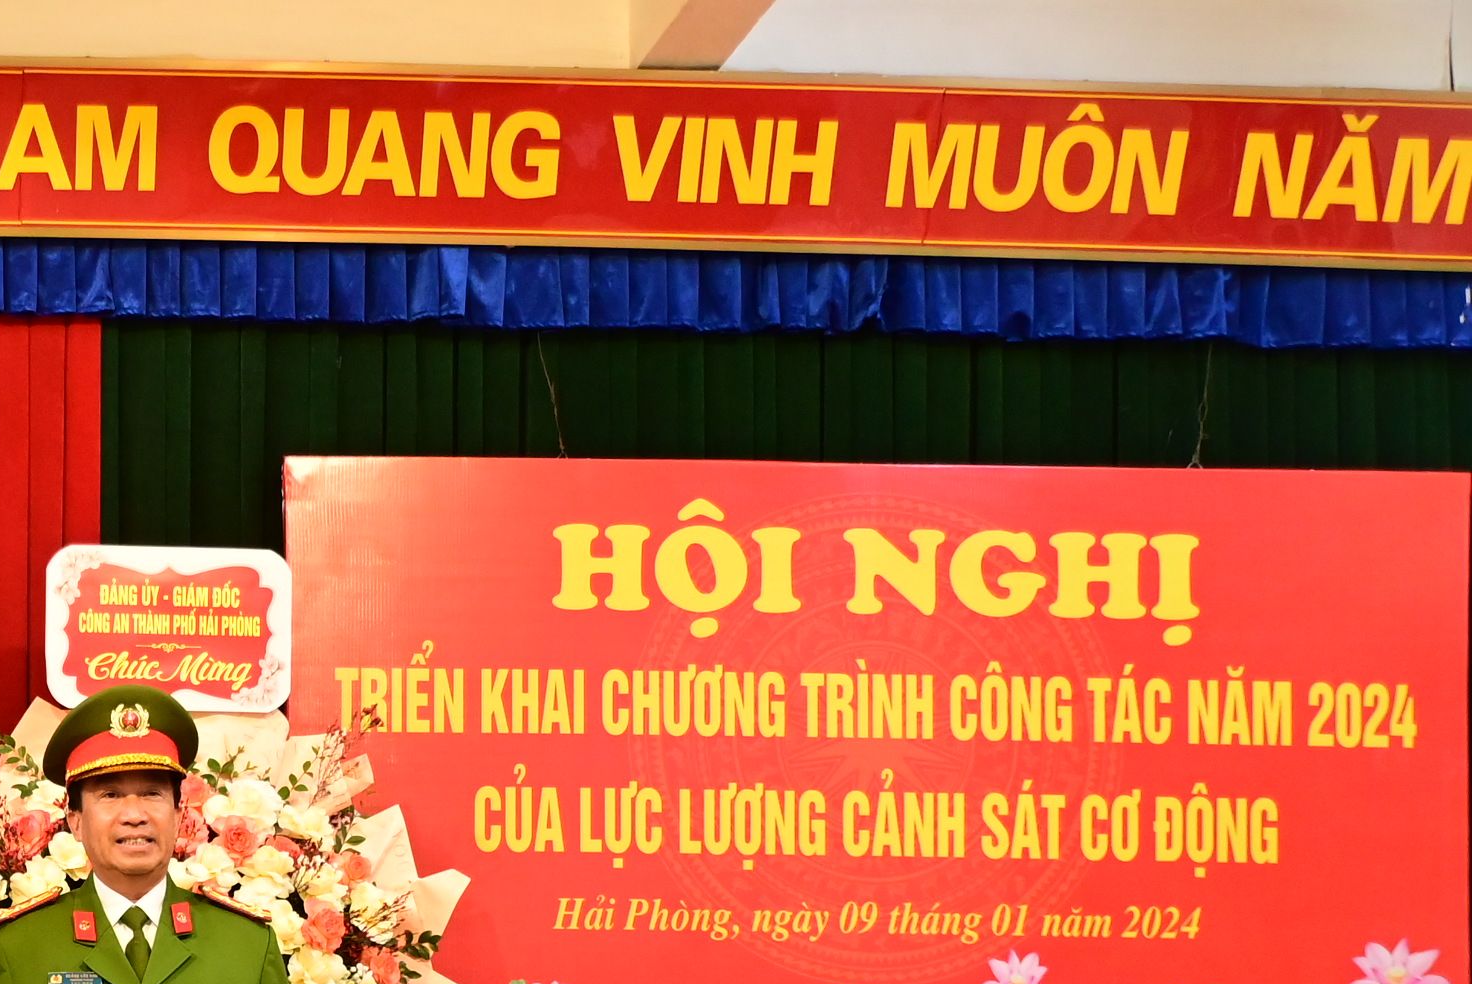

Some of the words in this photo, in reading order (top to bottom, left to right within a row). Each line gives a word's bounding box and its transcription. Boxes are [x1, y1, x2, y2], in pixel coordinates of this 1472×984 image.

[209, 106, 560, 198] QUANG
[613, 116, 838, 205] VINH
[886, 102, 1187, 215] MUÔN
[1234, 114, 1472, 225] NĂM
[100, 578, 138, 606] ĐẢNG
[141, 579, 159, 606] ỦY
[173, 583, 208, 608] GIÁM
[212, 581, 240, 608] ĐỐC
[552, 498, 801, 638] HỘI
[843, 528, 1199, 645] NGHỊ
[79, 608, 110, 633] CÔNG
[113, 613, 129, 633] AN
[133, 610, 170, 634] THÀNH
[173, 608, 196, 636] PHỐ
[199, 609, 218, 636] HẢI
[221, 611, 261, 637] PHÒNG
[85, 651, 162, 680] Chúc
[156, 652, 252, 691] Mừng
[335, 640, 464, 734] TRIỂN
[481, 669, 585, 734] KHAI
[602, 664, 786, 738] CHƯƠNG
[800, 659, 934, 740] TRÌNH
[949, 661, 1073, 743] CÔNG
[1087, 664, 1172, 744] TÁC
[1188, 665, 1292, 747] NĂM
[1308, 682, 1418, 749] 2024
[474, 764, 565, 853] CỦA
[580, 781, 663, 869] LỰC
[679, 783, 827, 870] LƯỢNG
[842, 768, 966, 858] CẢNH
[981, 780, 1066, 860] SÁT
[1080, 789, 1142, 862] CƠ
[1153, 783, 1279, 878] ĐỘNG
[553, 893, 614, 931] Hải
[623, 897, 741, 940] Phòng,
[751, 902, 830, 942] ngày
[839, 901, 879, 934] 09
[889, 901, 981, 944] tháng
[991, 904, 1029, 937] 01
[1040, 907, 1112, 938] năm
[1121, 906, 1202, 940] 2024
